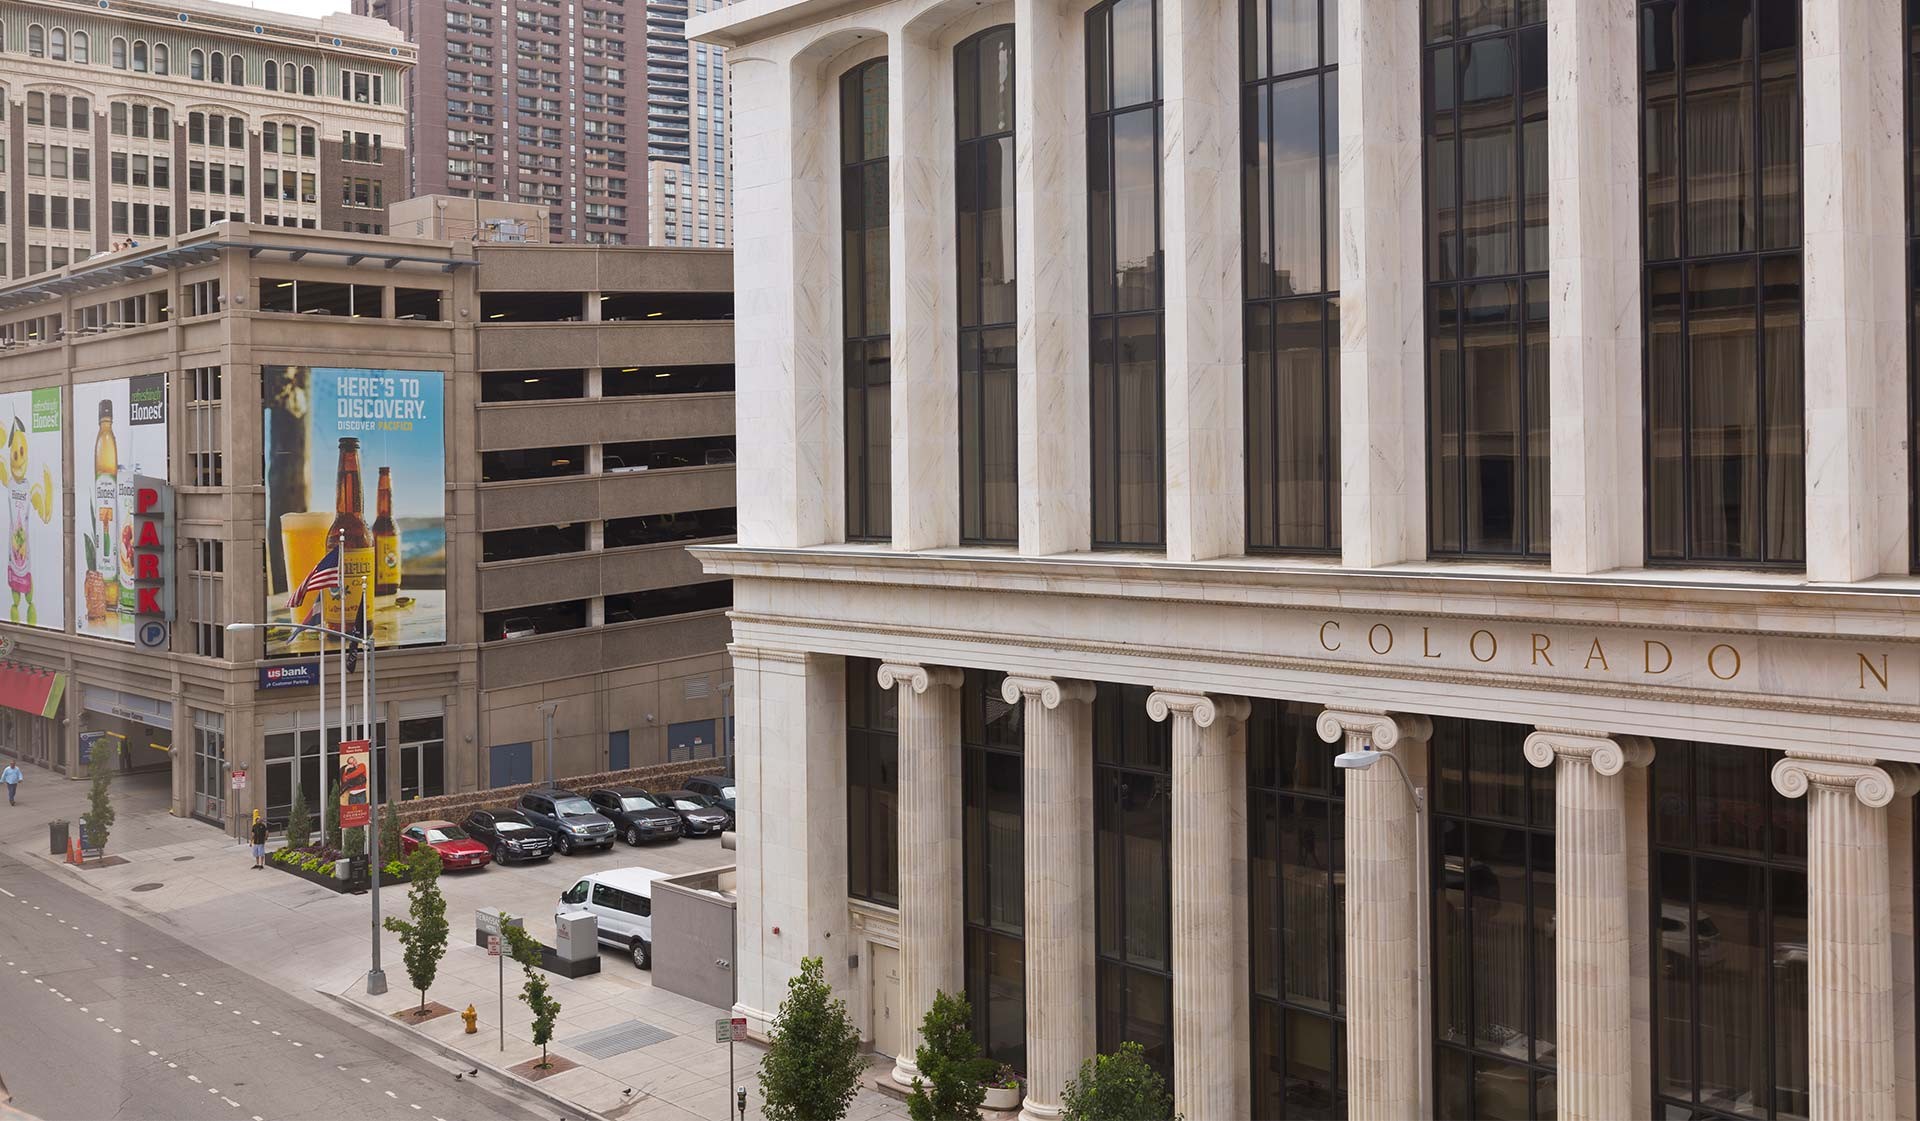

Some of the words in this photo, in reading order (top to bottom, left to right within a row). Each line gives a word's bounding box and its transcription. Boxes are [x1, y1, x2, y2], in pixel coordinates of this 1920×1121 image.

[337, 377, 395, 397] HERE'S
[400, 378, 420, 398] TO
[131, 402, 163, 421] Honest
[337, 398, 427, 419] DISCOVERY.
[33, 412, 59, 428] Honest
[337, 420, 376, 431] DISCOVER
[378, 421, 413, 431] PACIFICO
[138, 488, 161, 613] PARK
[146, 623, 162, 643] P
[1319, 619, 1742, 681] COLORADO
[1857, 652, 1889, 692] N
